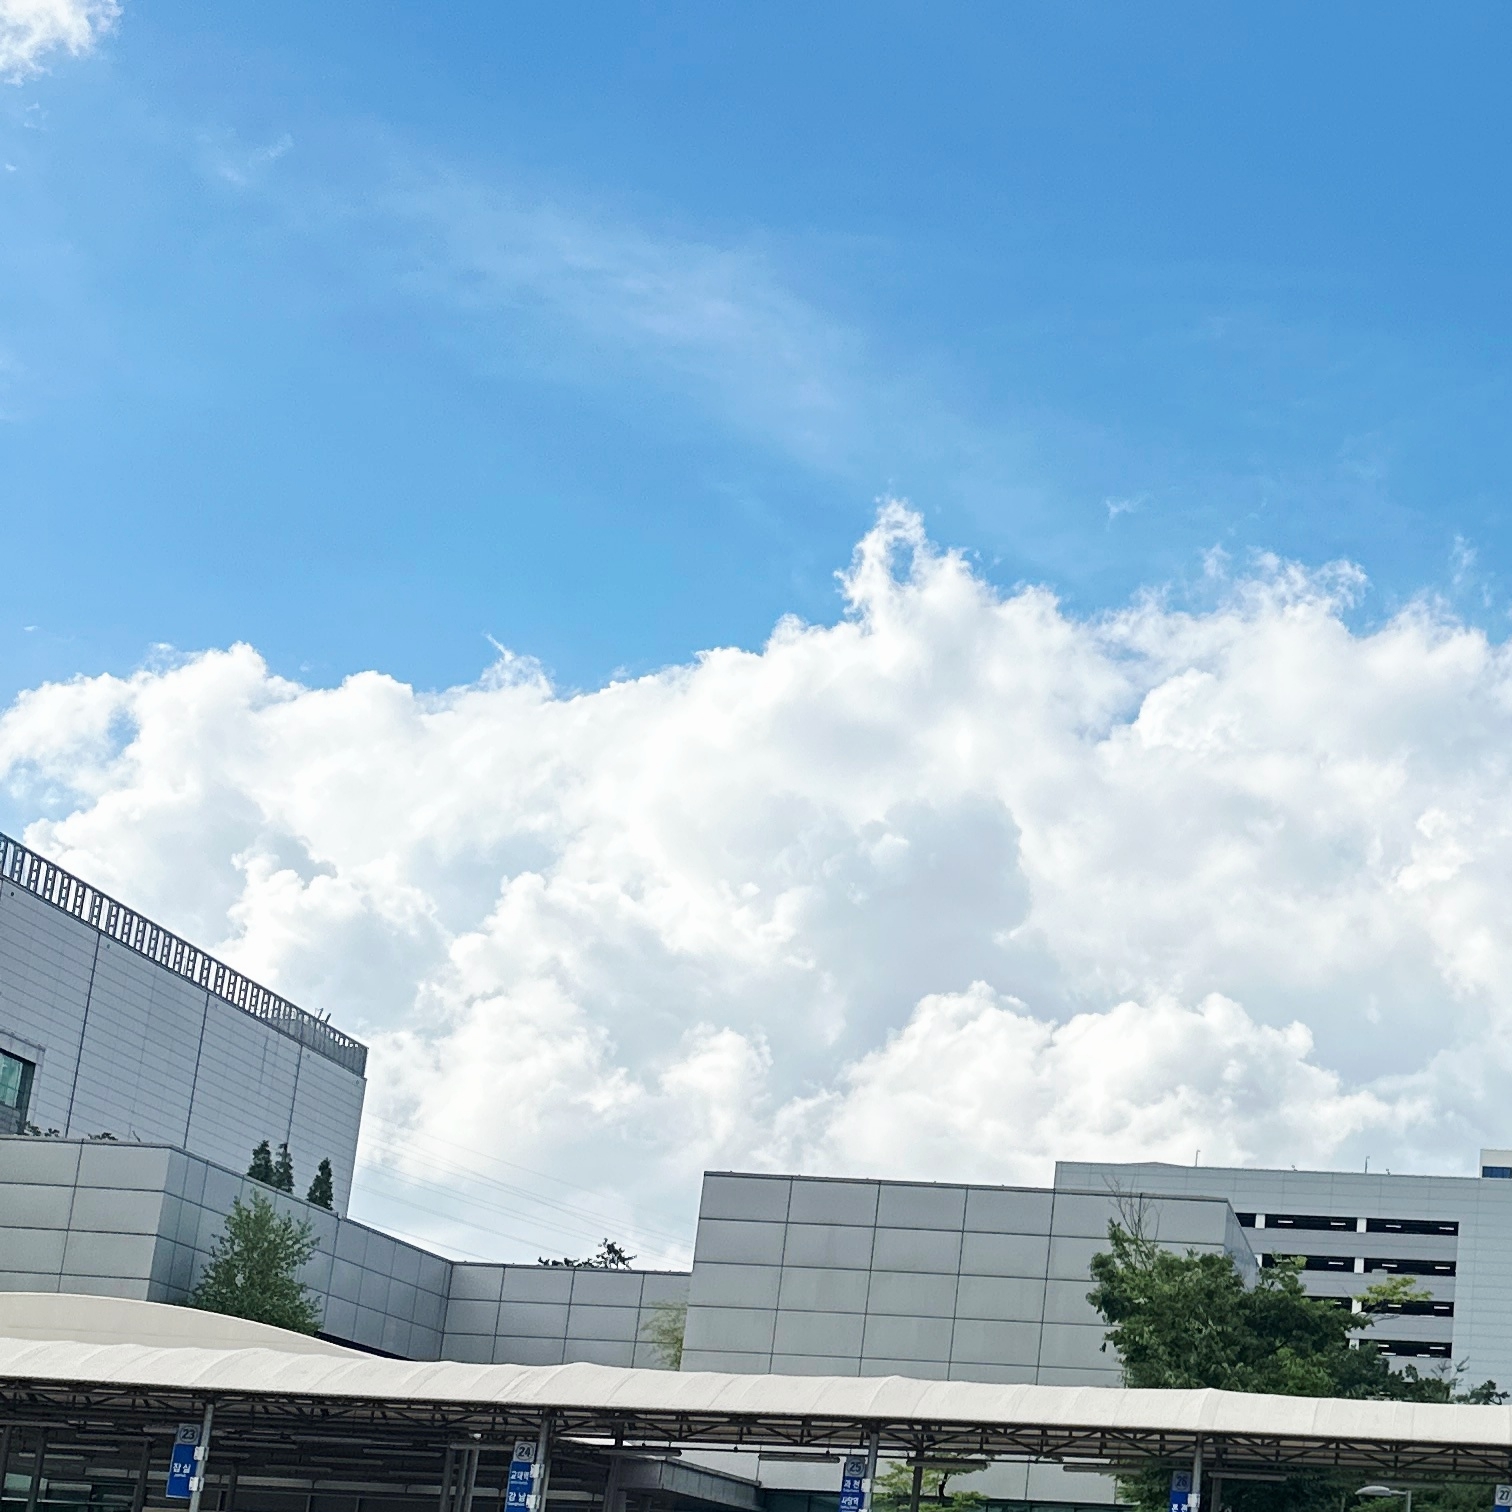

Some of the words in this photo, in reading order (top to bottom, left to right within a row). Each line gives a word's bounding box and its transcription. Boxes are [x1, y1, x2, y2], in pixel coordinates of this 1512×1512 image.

[181, 1428, 196, 1440] 23
[517, 1446, 531, 1458] 24
[172, 1462, 191, 1474] 잠실
[849, 1461, 862, 1473] 25
[1175, 1475, 1188, 1487] 26
[1499, 1489, 1511, 1501] 27
